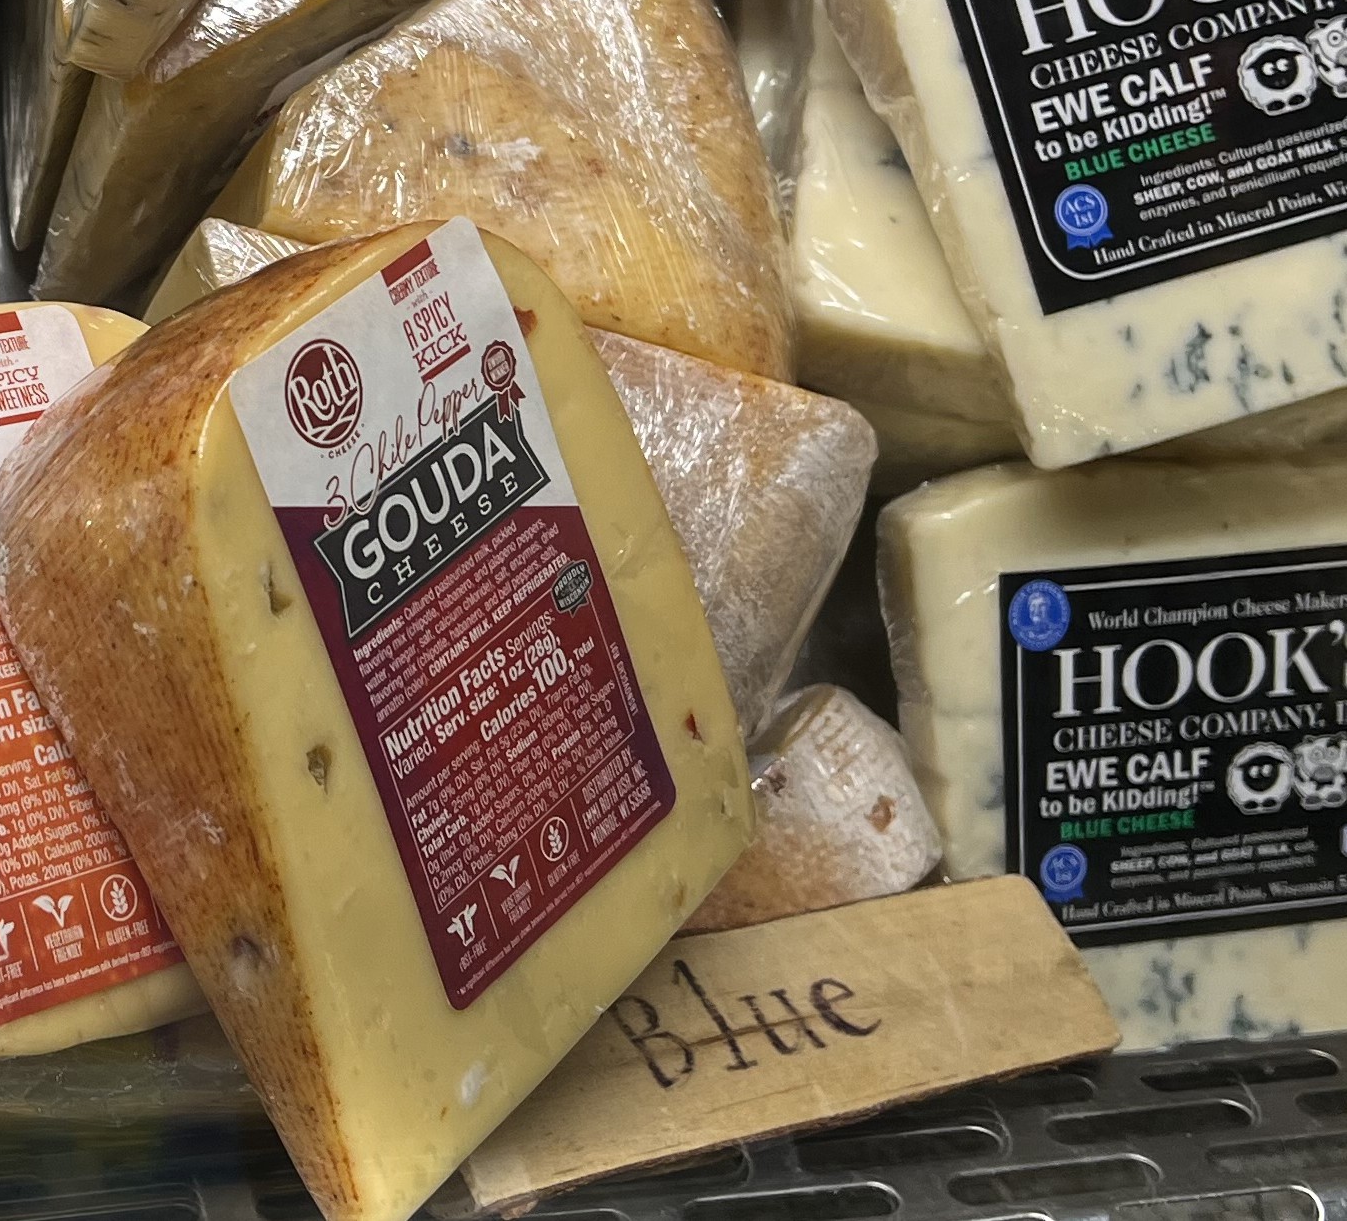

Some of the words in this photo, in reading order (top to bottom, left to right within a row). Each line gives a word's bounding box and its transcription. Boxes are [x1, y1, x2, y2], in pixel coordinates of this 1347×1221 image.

[1029, 32, 1163, 90] CHEESE
[1030, 82, 1117, 134] EWE
[1120, 53, 1213, 107] CALF
[1034, 139, 1063, 162] to
[1064, 130, 1099, 154] be
[1064, 148, 1125, 181] BLUE
[1128, 123, 1217, 163] CHEESE
[402, 319, 419, 352] A
[413, 291, 456, 343] SPICY
[412, 322, 468, 373] KICK
[290, 344, 358, 431] Roth
[323, 475, 349, 530] 3
[350, 415, 417, 517] Chile
[416, 377, 485, 451] Pepper
[328, 428, 362, 460] CHEESE
[343, 420, 517, 581] GOUDA
[366, 471, 519, 606] CHEESE
[384, 684, 462, 761] Nutrition
[458, 646, 507, 697] Facts
[479, 684, 537, 742] Calories
[531, 648, 576, 693] 100,
[1053, 718, 1172, 753] CHEESE
[1179, 702, 1326, 740] COMPANY,
[1046, 756, 1119, 792] EWE
[1126, 746, 1211, 784] CALF
[1039, 796, 1063, 818] to
[1068, 794, 1097, 815] be
[609, 959, 882, 1090] Blue
